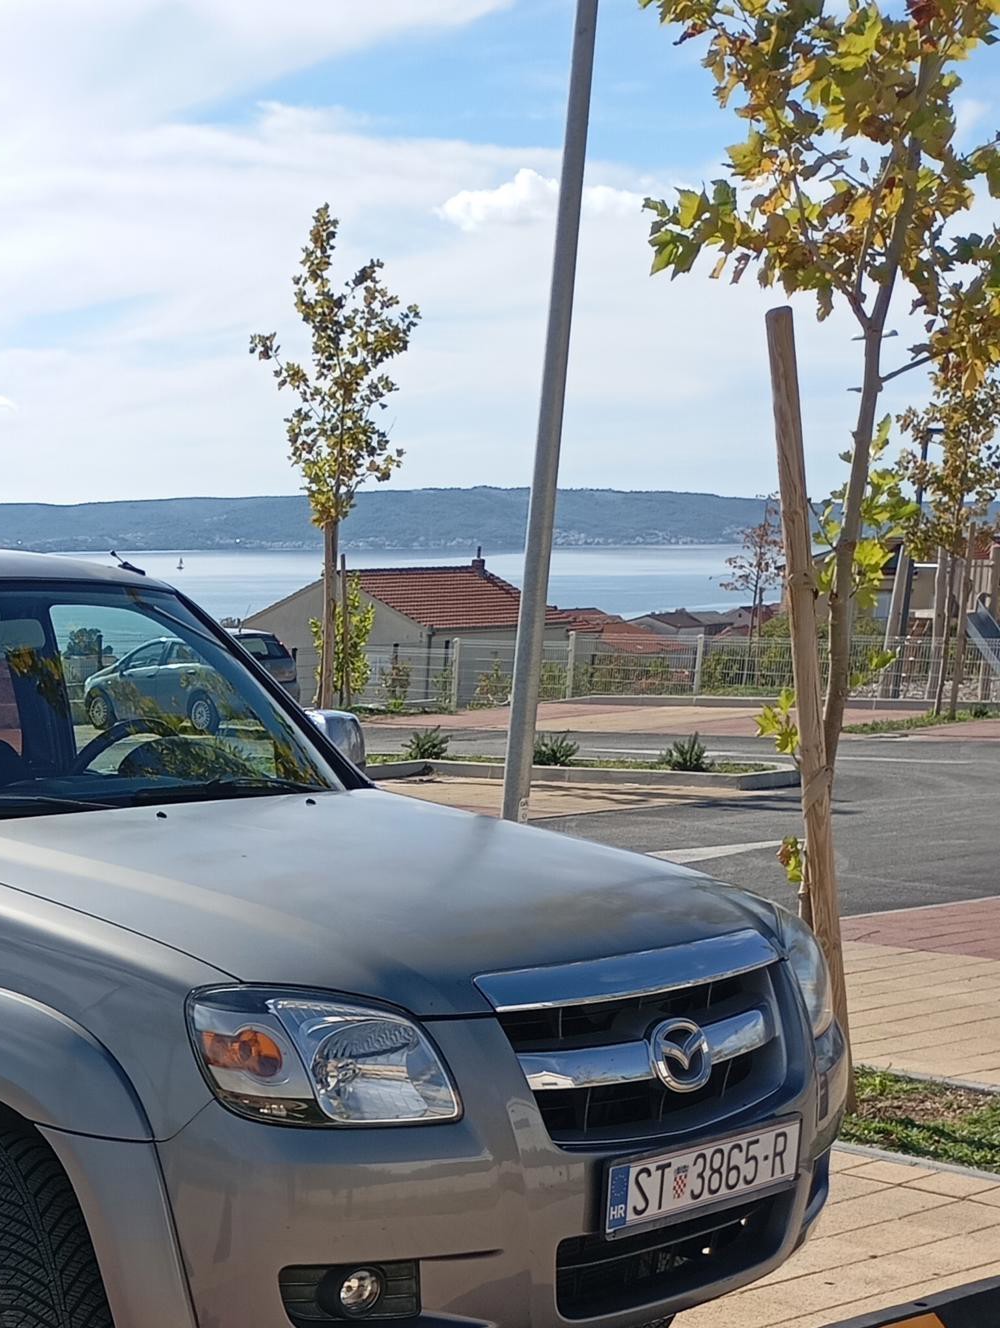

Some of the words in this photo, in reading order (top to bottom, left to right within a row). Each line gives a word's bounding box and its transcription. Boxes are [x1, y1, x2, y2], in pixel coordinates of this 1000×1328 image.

[633, 1162, 671, 1215] ST
[690, 1131, 788, 1200] 3865-R
[610, 1205, 625, 1219] HR
